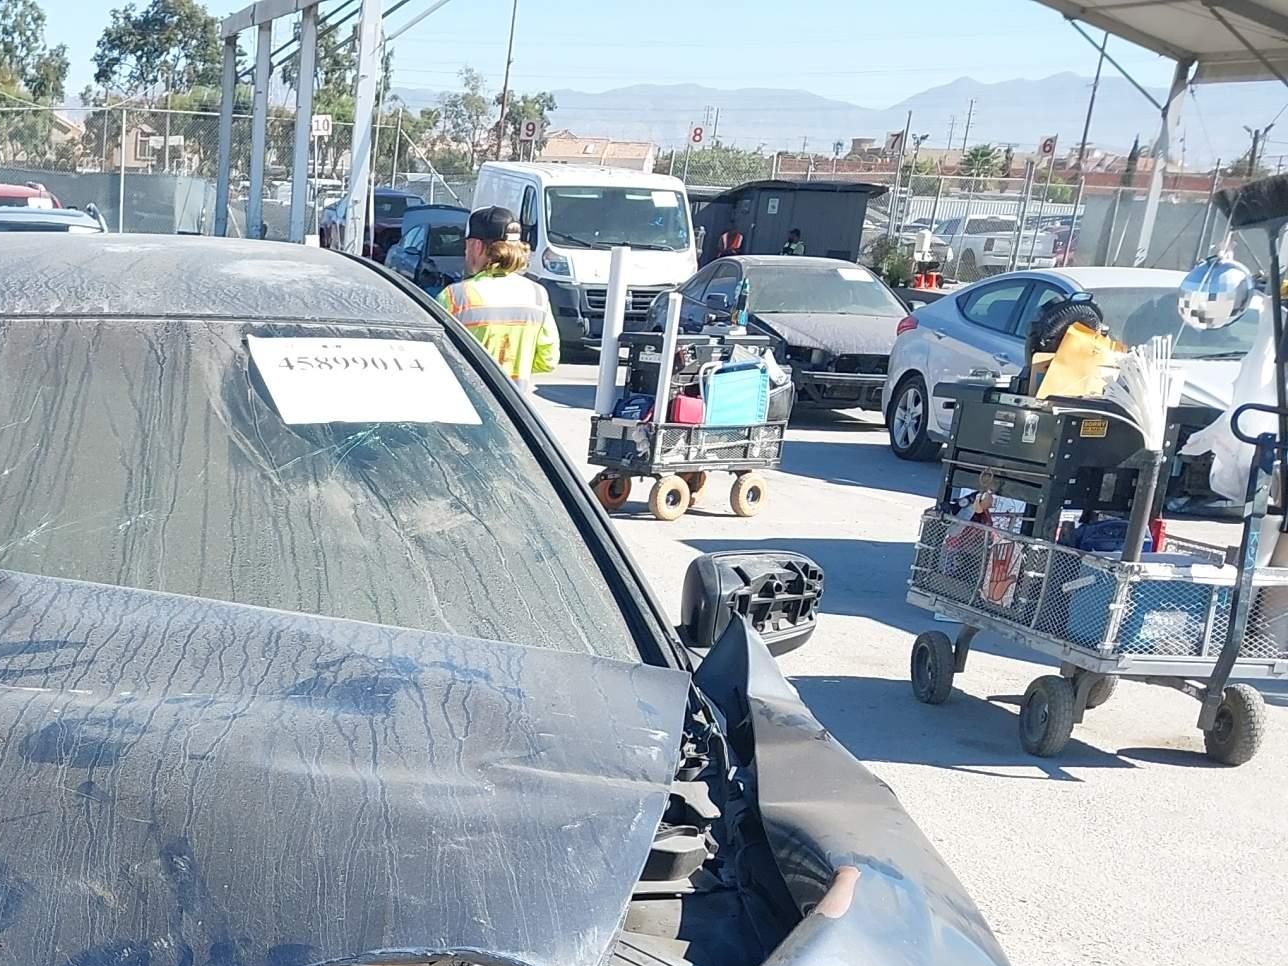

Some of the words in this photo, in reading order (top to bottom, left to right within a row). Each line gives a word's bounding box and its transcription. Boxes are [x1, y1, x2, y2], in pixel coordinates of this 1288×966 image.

[314, 119, 329, 132] 10
[525, 122, 536, 138] 9
[691, 127, 703, 143] 8
[890, 134, 901, 149] 7
[1042, 138, 1054, 154] 6
[278, 356, 425, 373] 45899014
